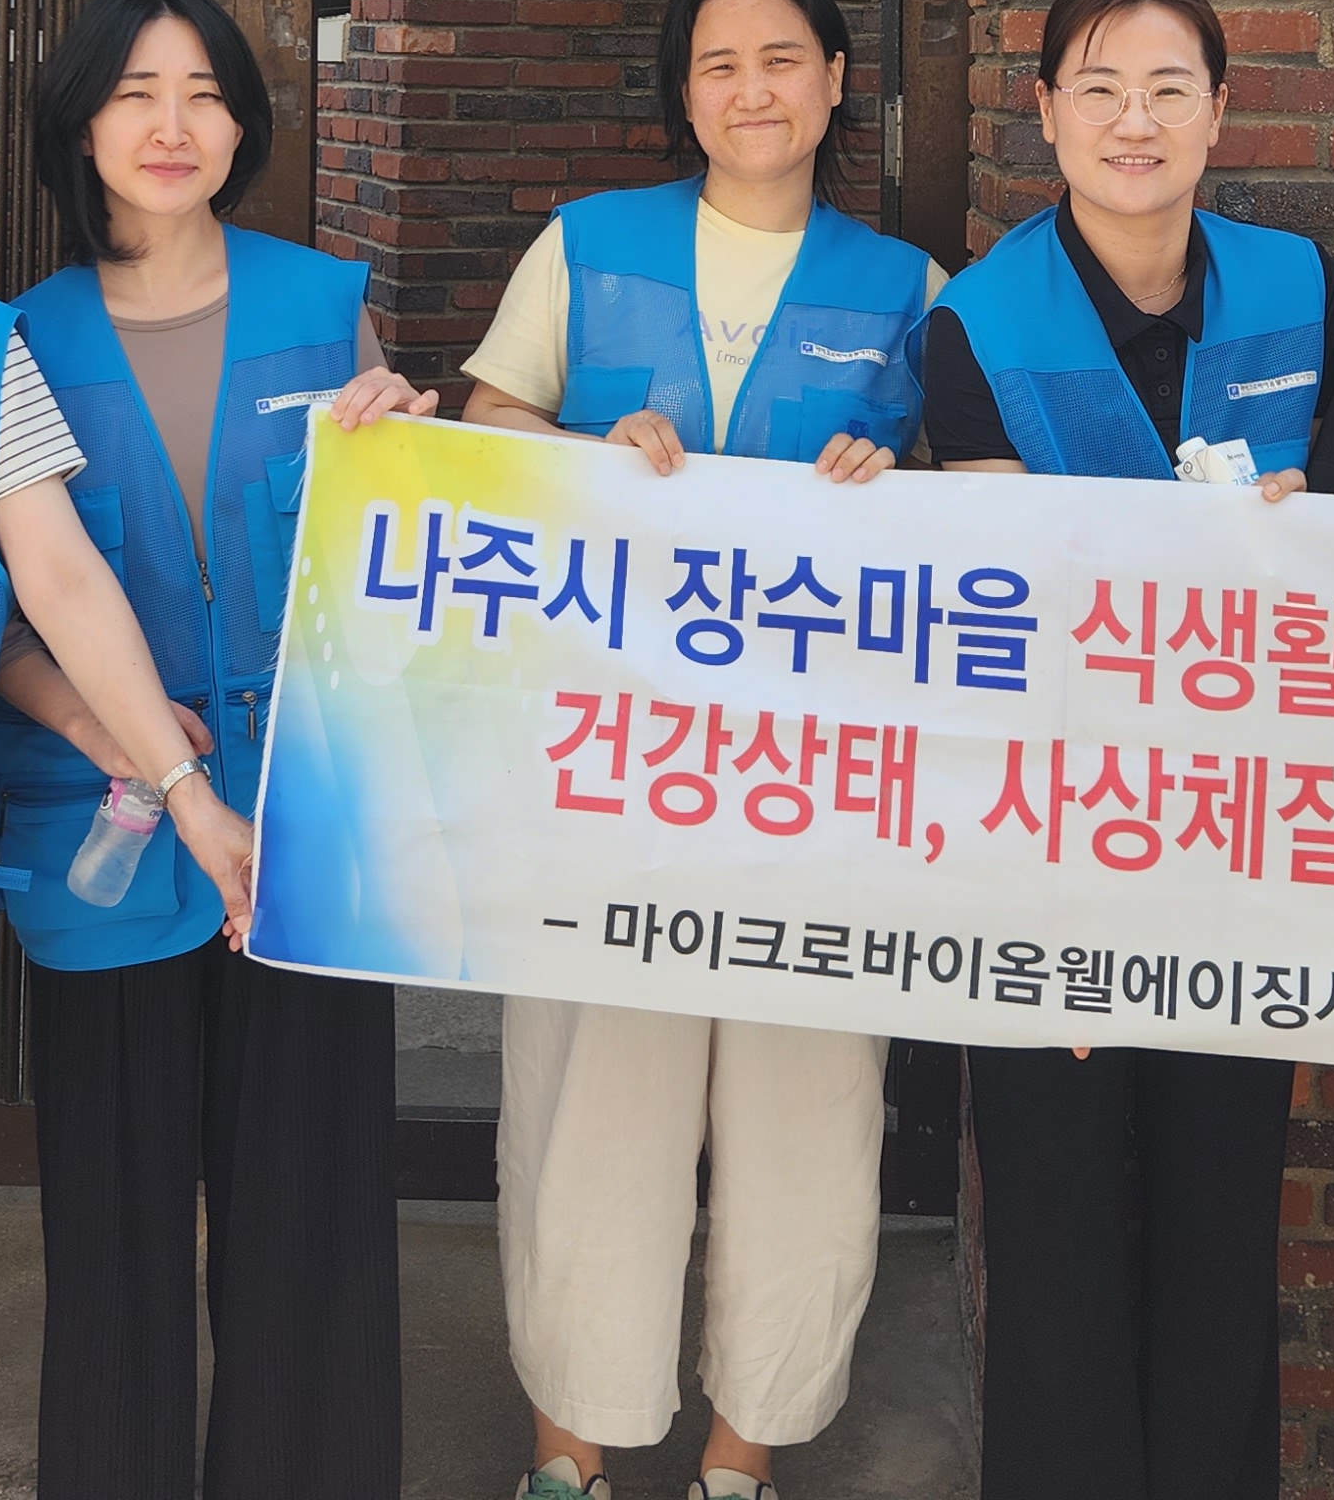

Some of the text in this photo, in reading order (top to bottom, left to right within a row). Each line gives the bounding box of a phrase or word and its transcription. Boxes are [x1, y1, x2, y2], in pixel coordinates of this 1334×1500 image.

[364, 511, 630, 651] 나주시
[665, 547, 1038, 692] 장수마을
[545, 690, 945, 865] 건강상태,
